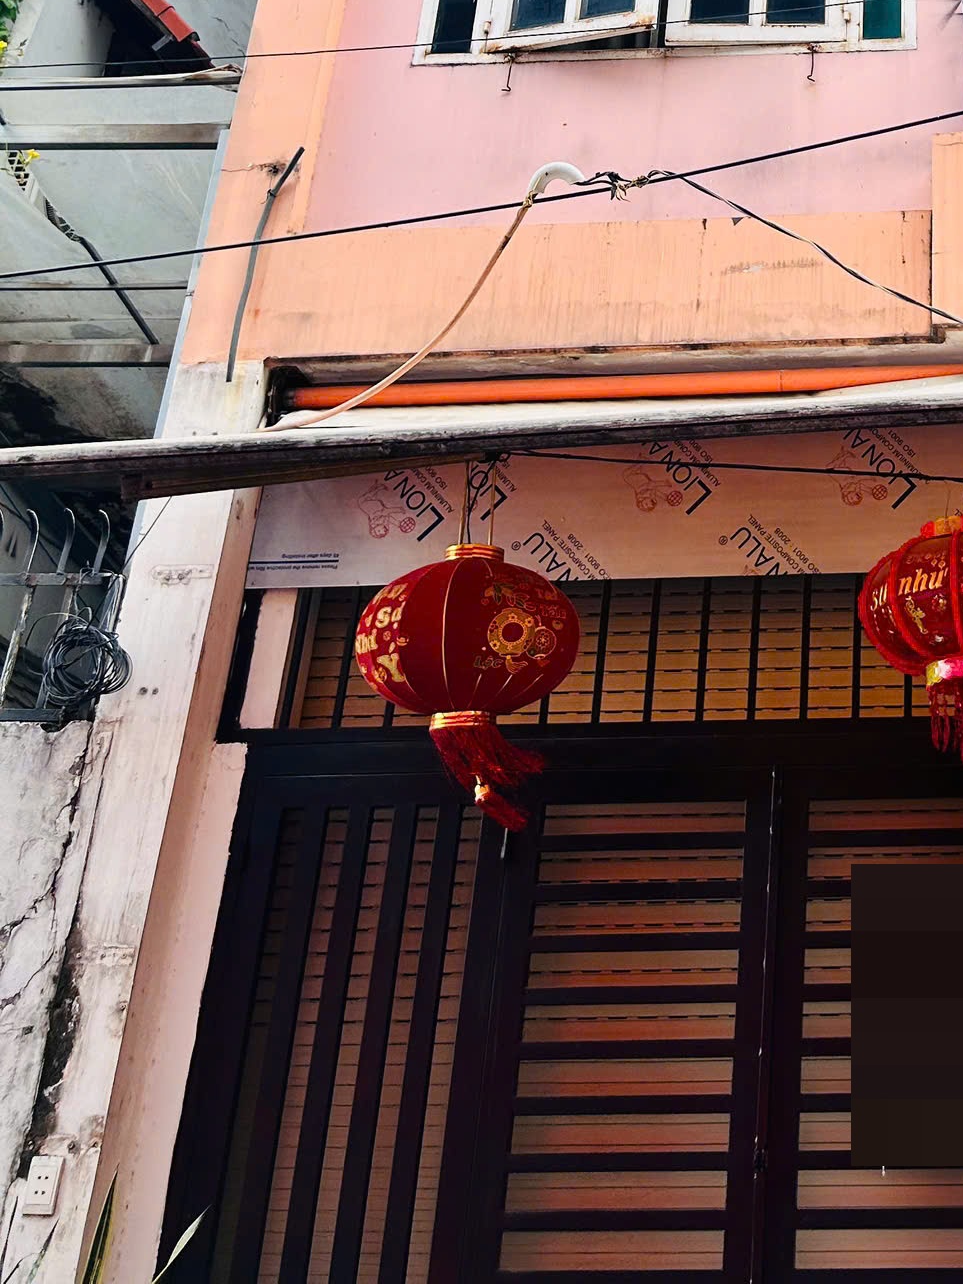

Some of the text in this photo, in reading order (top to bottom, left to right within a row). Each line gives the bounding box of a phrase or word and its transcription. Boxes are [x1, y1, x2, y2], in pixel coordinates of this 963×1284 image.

[902, 444, 917, 458] ISO
[434, 476, 448, 491] ISO
[424, 481, 454, 514] ALUMINIUM
[541, 519, 561, 542] PANEL
[747, 513, 767, 536] PANEL
[773, 527, 792, 545] 2008
[556, 538, 591, 576] COMPOSITE
[584, 552, 601, 570] 9001
[763, 532, 800, 570] COMPOSITE
[792, 546, 810, 565] 9001
